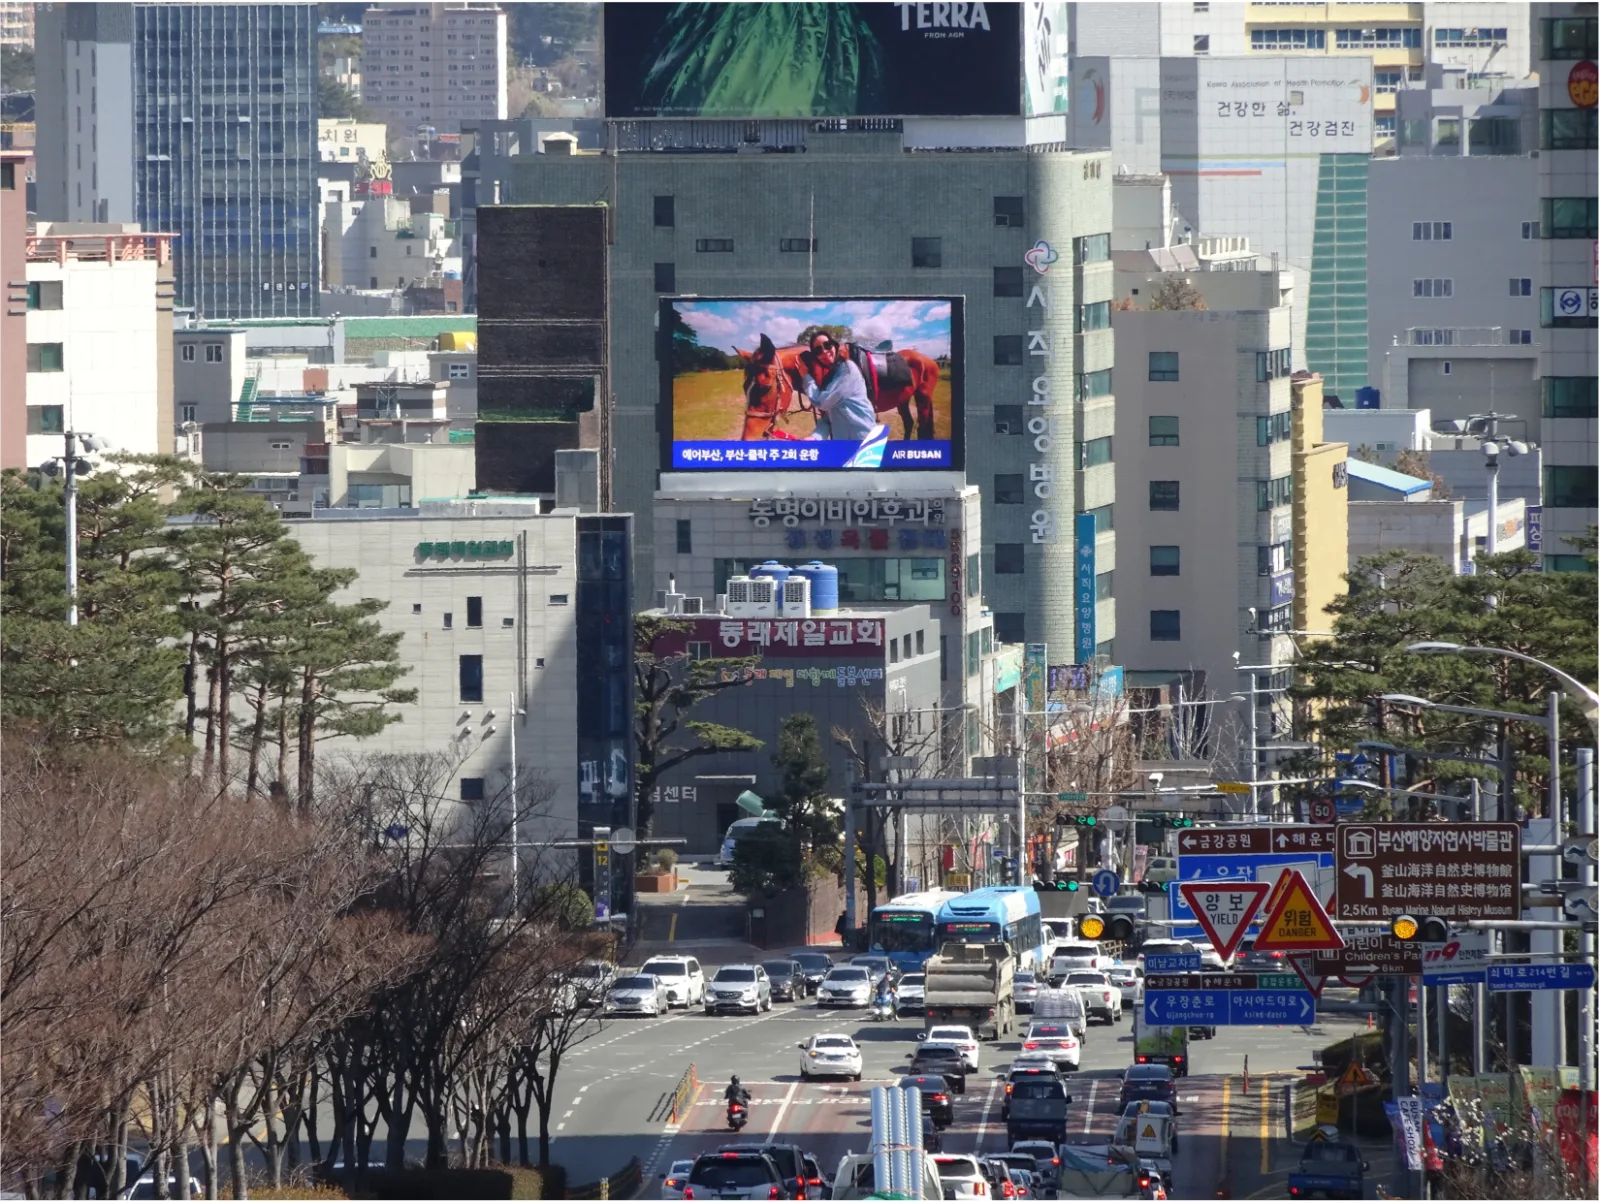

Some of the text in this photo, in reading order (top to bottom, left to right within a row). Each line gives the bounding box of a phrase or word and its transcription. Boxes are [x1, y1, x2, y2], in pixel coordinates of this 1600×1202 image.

[894, 2, 991, 31] TERRA
[1207, 78, 1345, 88] Korea Association of Health Promotion
[1217, 101, 1266, 118] 건강한
[1290, 121, 1355, 137] 건강검진
[1026, 285, 1058, 545] 사직요양병원
[682, 448, 724, 462] 에어부산,
[769, 448, 780, 461] 주
[781, 448, 798, 461] 2회
[799, 448, 819, 461] 운항
[892, 450, 942, 460] AIR BUSAN
[1081, 563, 1093, 649] 사직요양병원
[719, 619, 883, 648] 동래제일교회
[769, 668, 795, 688] 제일
[1314, 804, 1331, 817] 50
[1199, 833, 1251, 849] 금강공원
[1378, 829, 1513, 852] 부산해양자연사박물관
[597, 855, 608, 866] 12
[1381, 862, 1513, 879] 釜山海洋自然史博物館
[1381, 883, 1513, 899] 釜山海洋自然史博物馆
[1342, 904, 1378, 916] 2.5Km
[1382, 904, 1513, 917] Busan Marine Natural History Museum
[1210, 913, 1239, 926] YIELD
[1284, 909, 1312, 927] 위험
[1278, 927, 1317, 938] DANGER
[1147, 954, 1199, 970] 미남교차로
[1345, 951, 1401, 961] Children's
[1158, 977, 1190, 988] 금강공원
[1213, 976, 1243, 987] 해운대
[1165, 995, 1216, 1009] 우장춘로
[1233, 995, 1297, 1007] 아시아드대로
[1409, 1100, 1421, 1133] BUSAN
